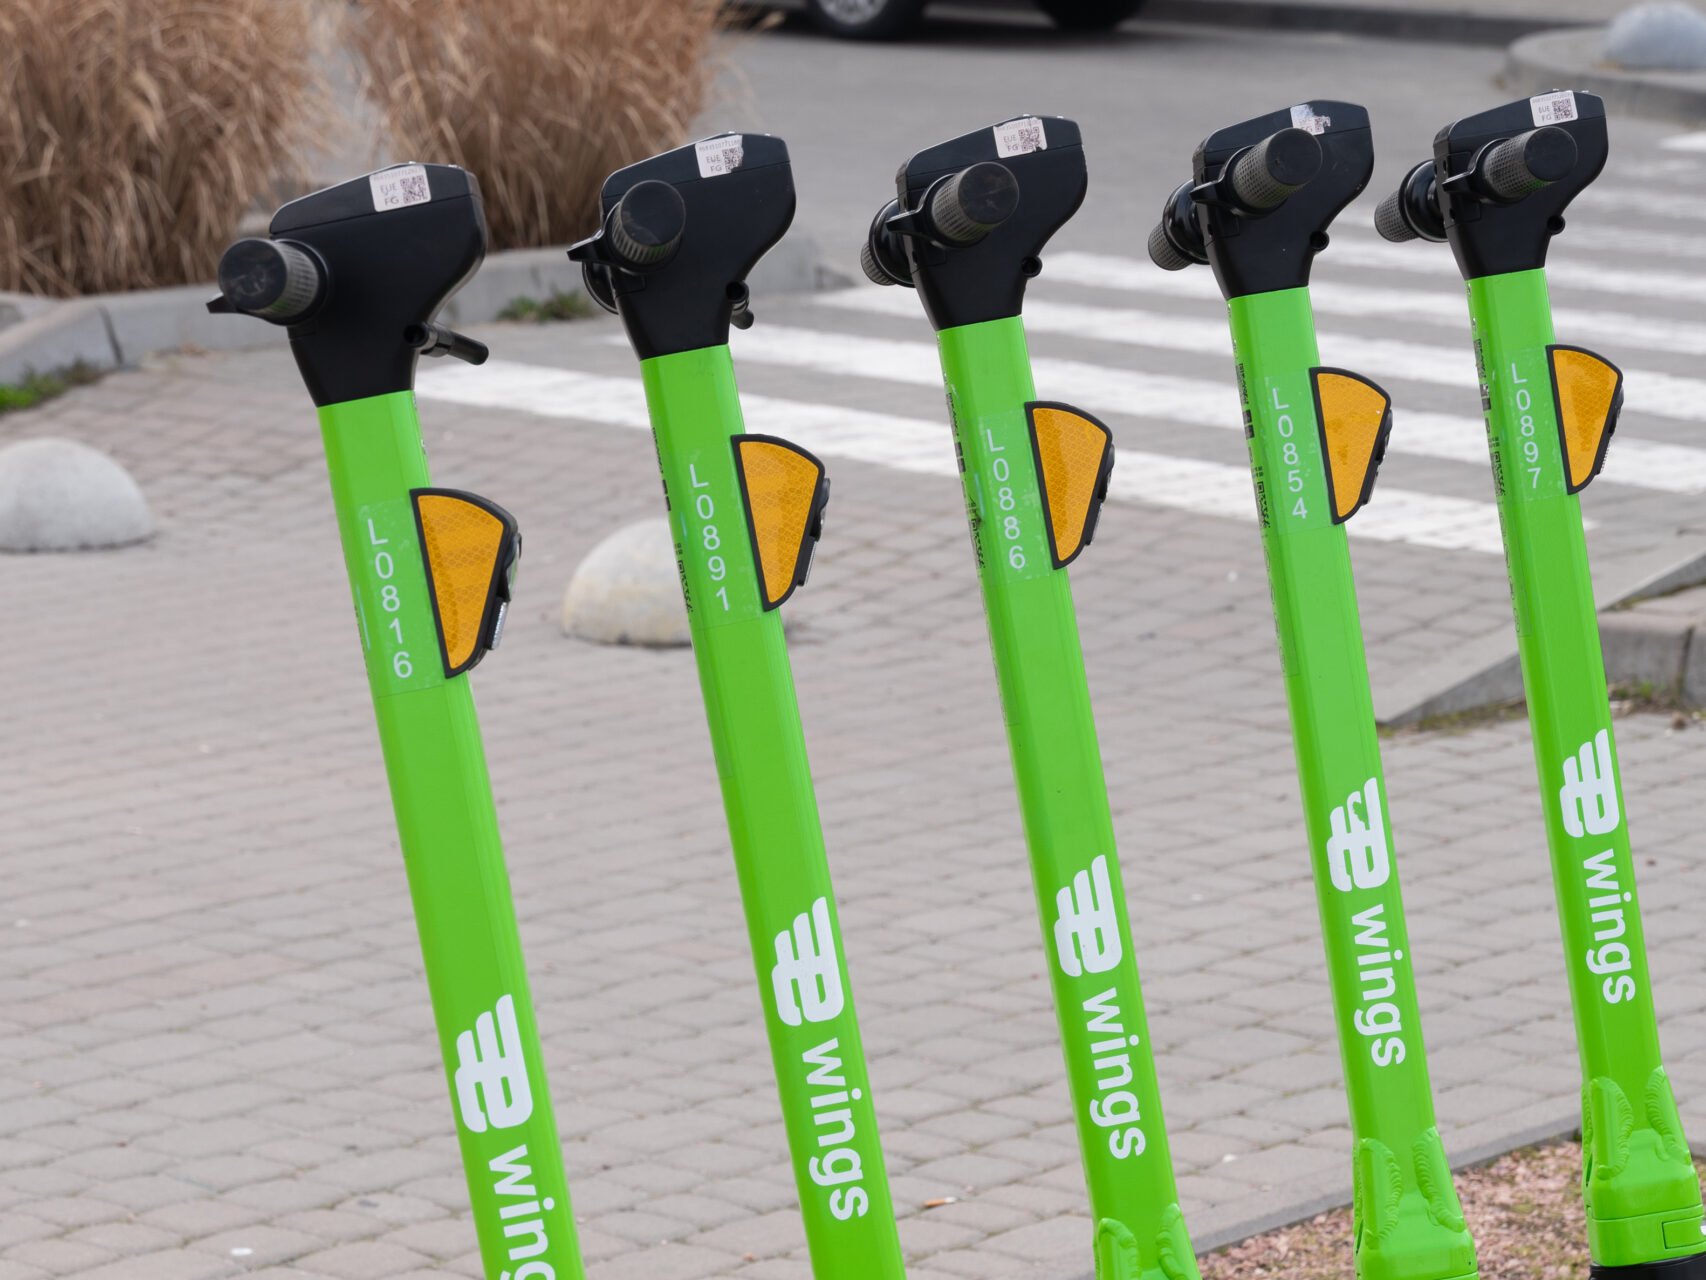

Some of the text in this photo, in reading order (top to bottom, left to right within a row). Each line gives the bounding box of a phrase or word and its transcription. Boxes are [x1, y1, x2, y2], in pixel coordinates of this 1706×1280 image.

[986, 428, 1026, 570] L0886
[1272, 387, 1308, 519] L0854
[1511, 362, 1541, 489] L0897
[367, 518, 413, 679] L0816
[689, 463, 729, 611] L0891
[1352, 904, 1406, 1067] wings
[1584, 849, 1636, 1004] wings
[802, 1038, 869, 1221] wings
[1083, 988, 1147, 1160] wings
